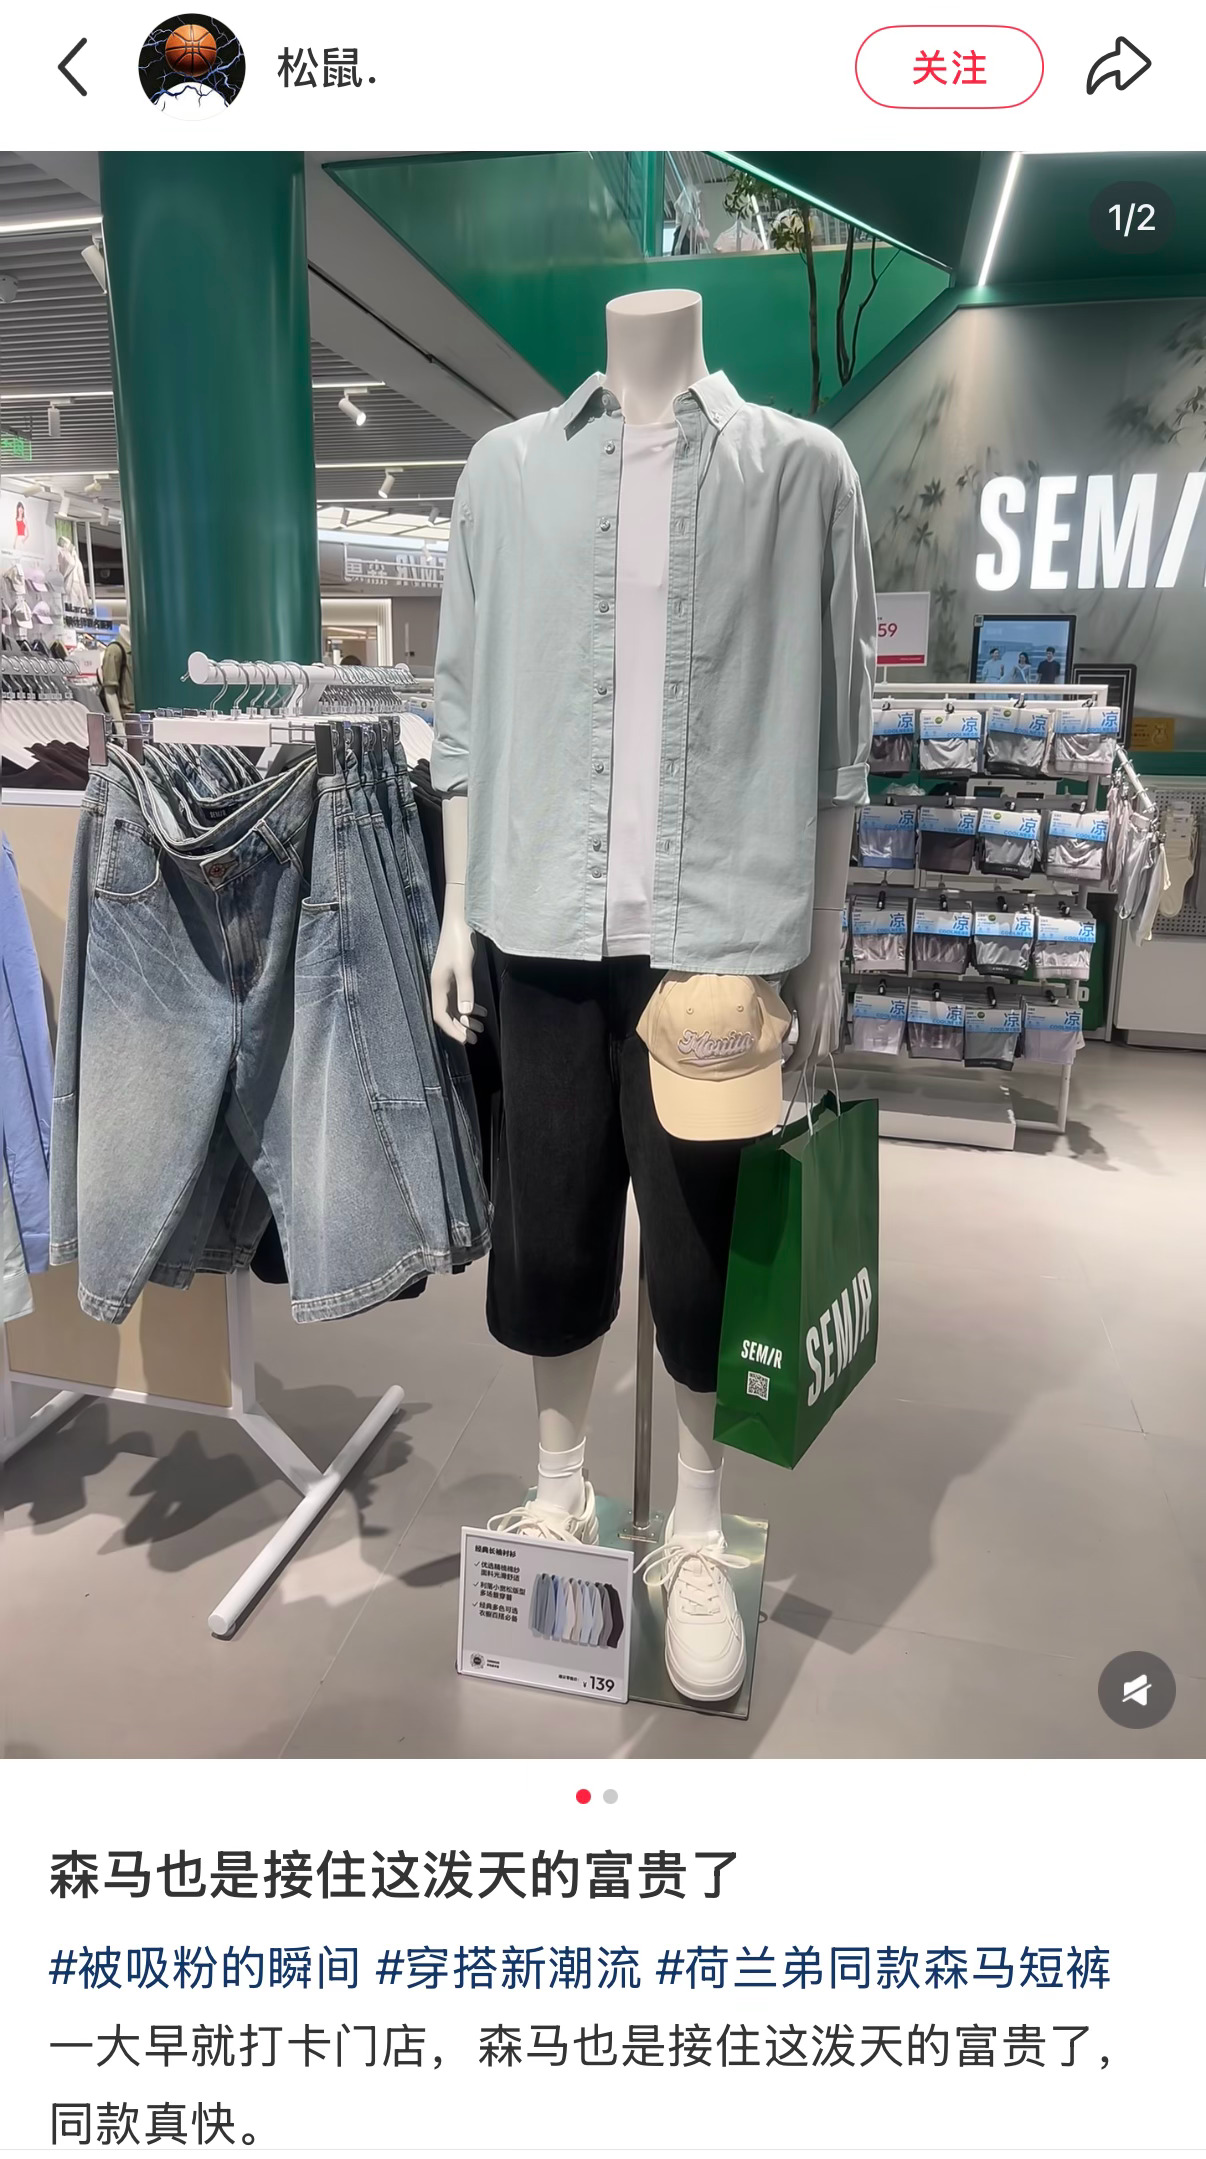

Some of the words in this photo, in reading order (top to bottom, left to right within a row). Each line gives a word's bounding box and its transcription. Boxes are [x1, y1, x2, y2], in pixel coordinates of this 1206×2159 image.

[975, 472, 1206, 591] SEM/
[741, 1339, 783, 1370] SEM/R
[806, 1266, 872, 1407] SEM/R
